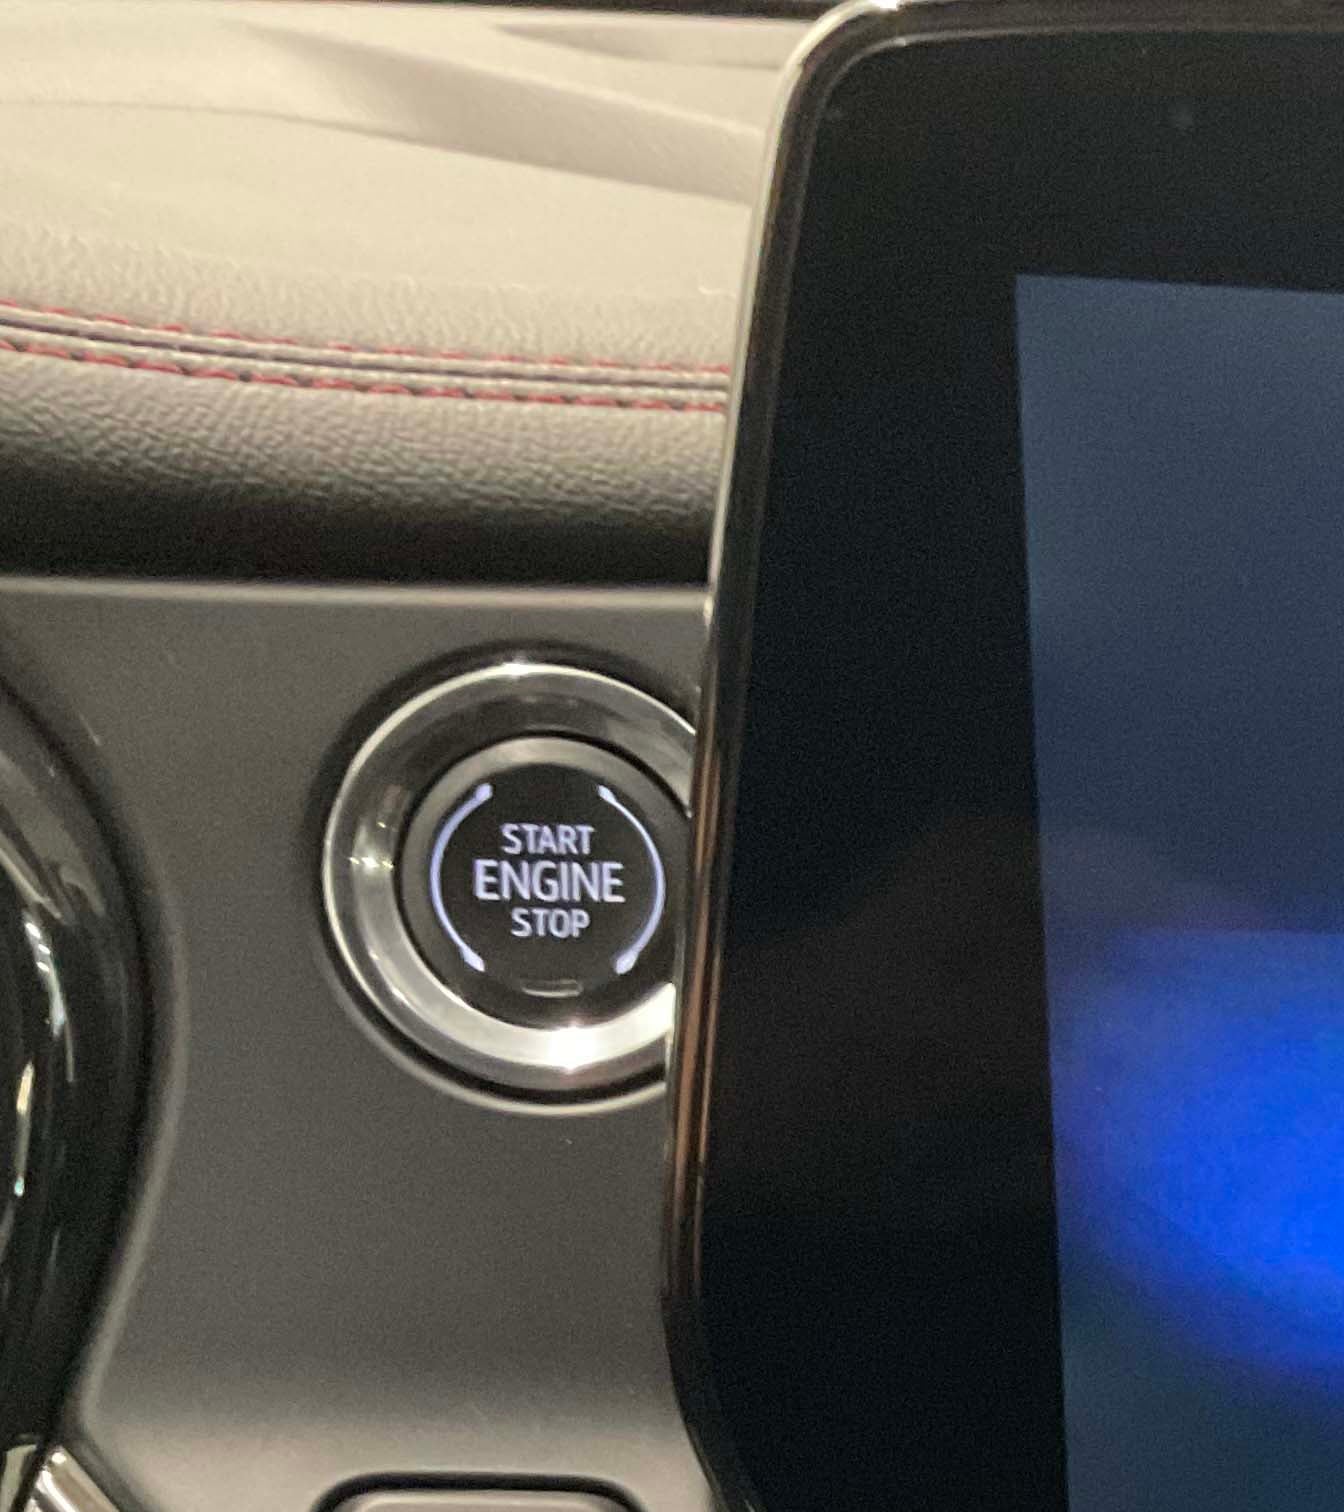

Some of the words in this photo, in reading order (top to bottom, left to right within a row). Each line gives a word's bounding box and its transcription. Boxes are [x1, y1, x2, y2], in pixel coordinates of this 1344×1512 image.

[501, 822, 595, 855] START
[472, 859, 626, 903] ENGINE
[511, 907, 590, 938] STOP
